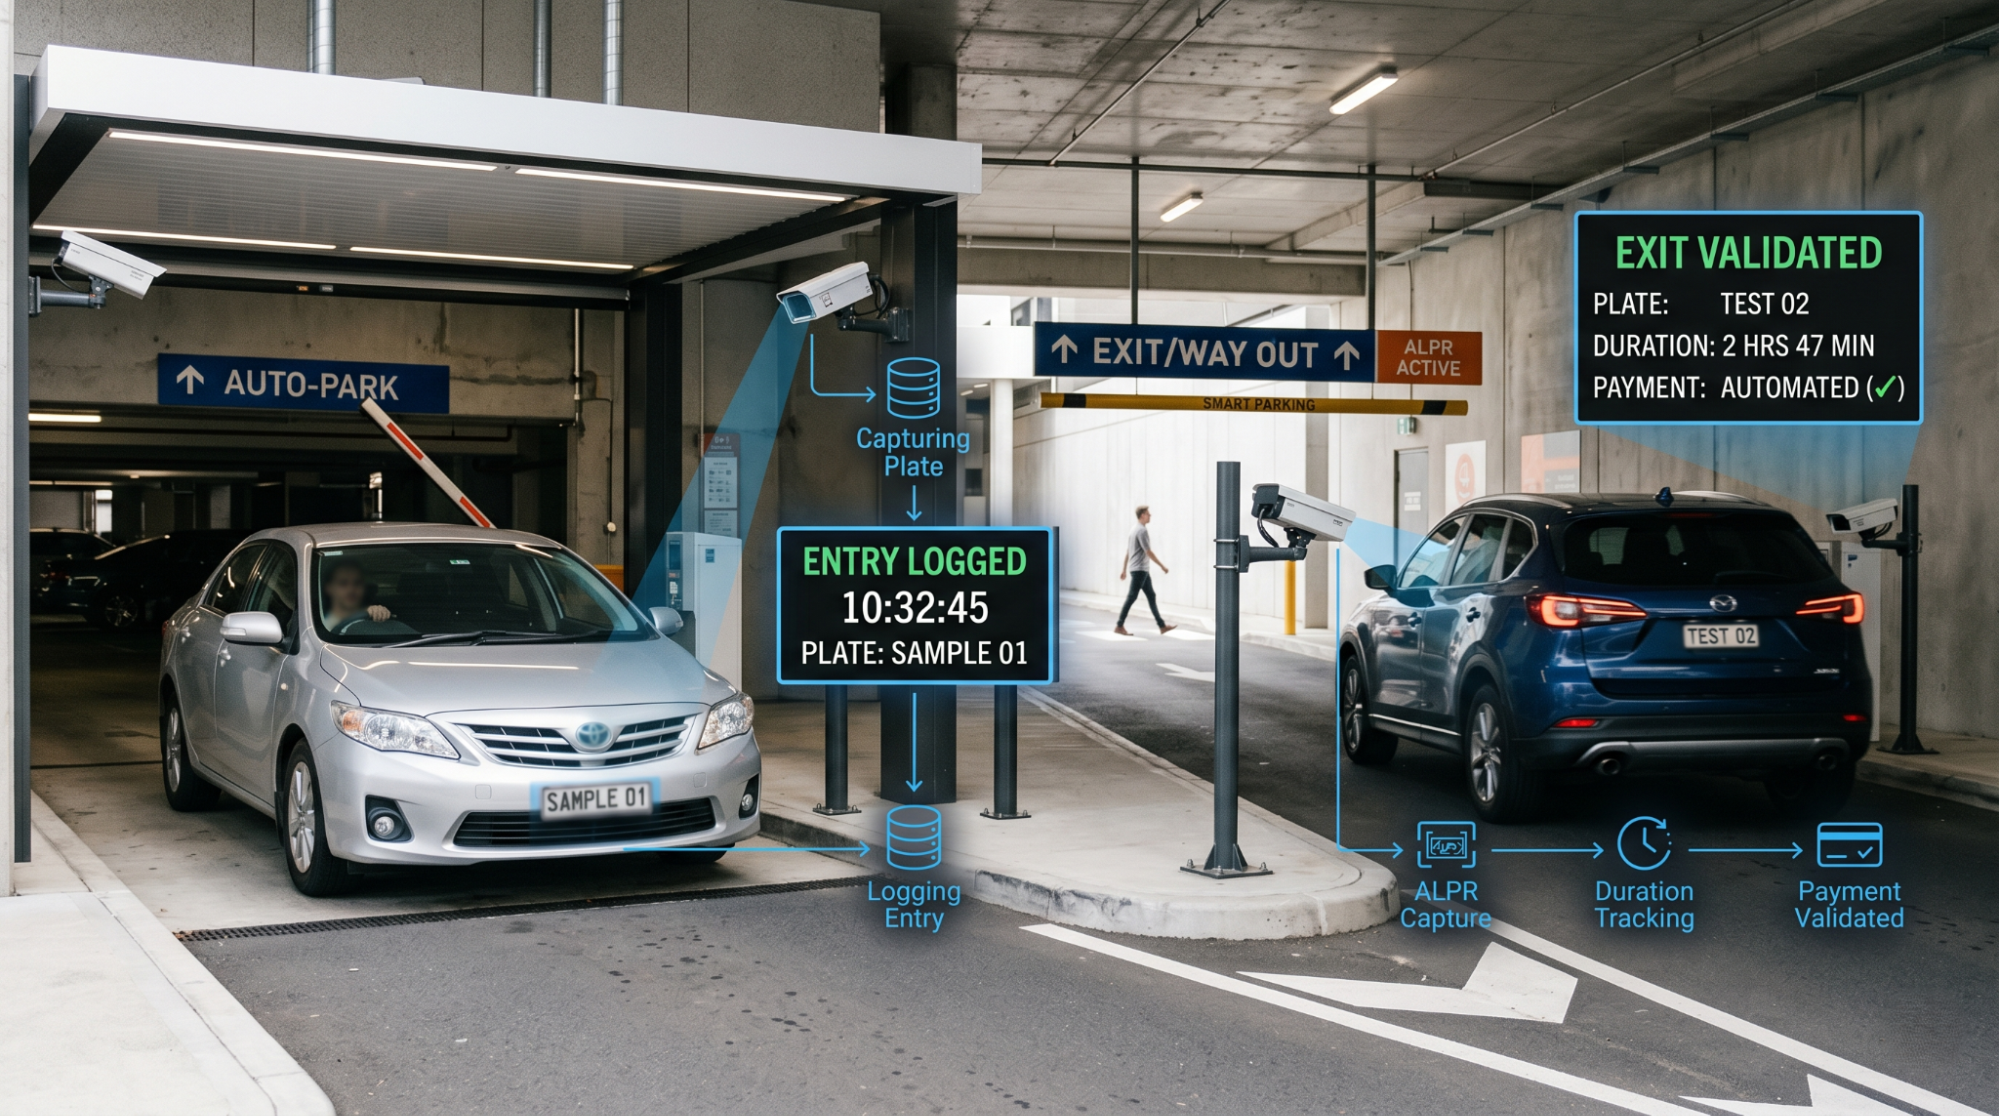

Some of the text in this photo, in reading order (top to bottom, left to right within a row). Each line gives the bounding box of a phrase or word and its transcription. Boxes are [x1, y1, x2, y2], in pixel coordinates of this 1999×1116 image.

[1093, 337, 1319, 368] EXIT/WAY OUT
[1403, 338, 1453, 356] ALPR
[1396, 358, 1461, 377] ACTIVE
[224, 369, 399, 401] AUTO-PARK
[1203, 397, 1316, 411] SMART PARKING
[1687, 627, 1756, 645] TEST 02
[547, 786, 645, 812] SAMPLE 01
